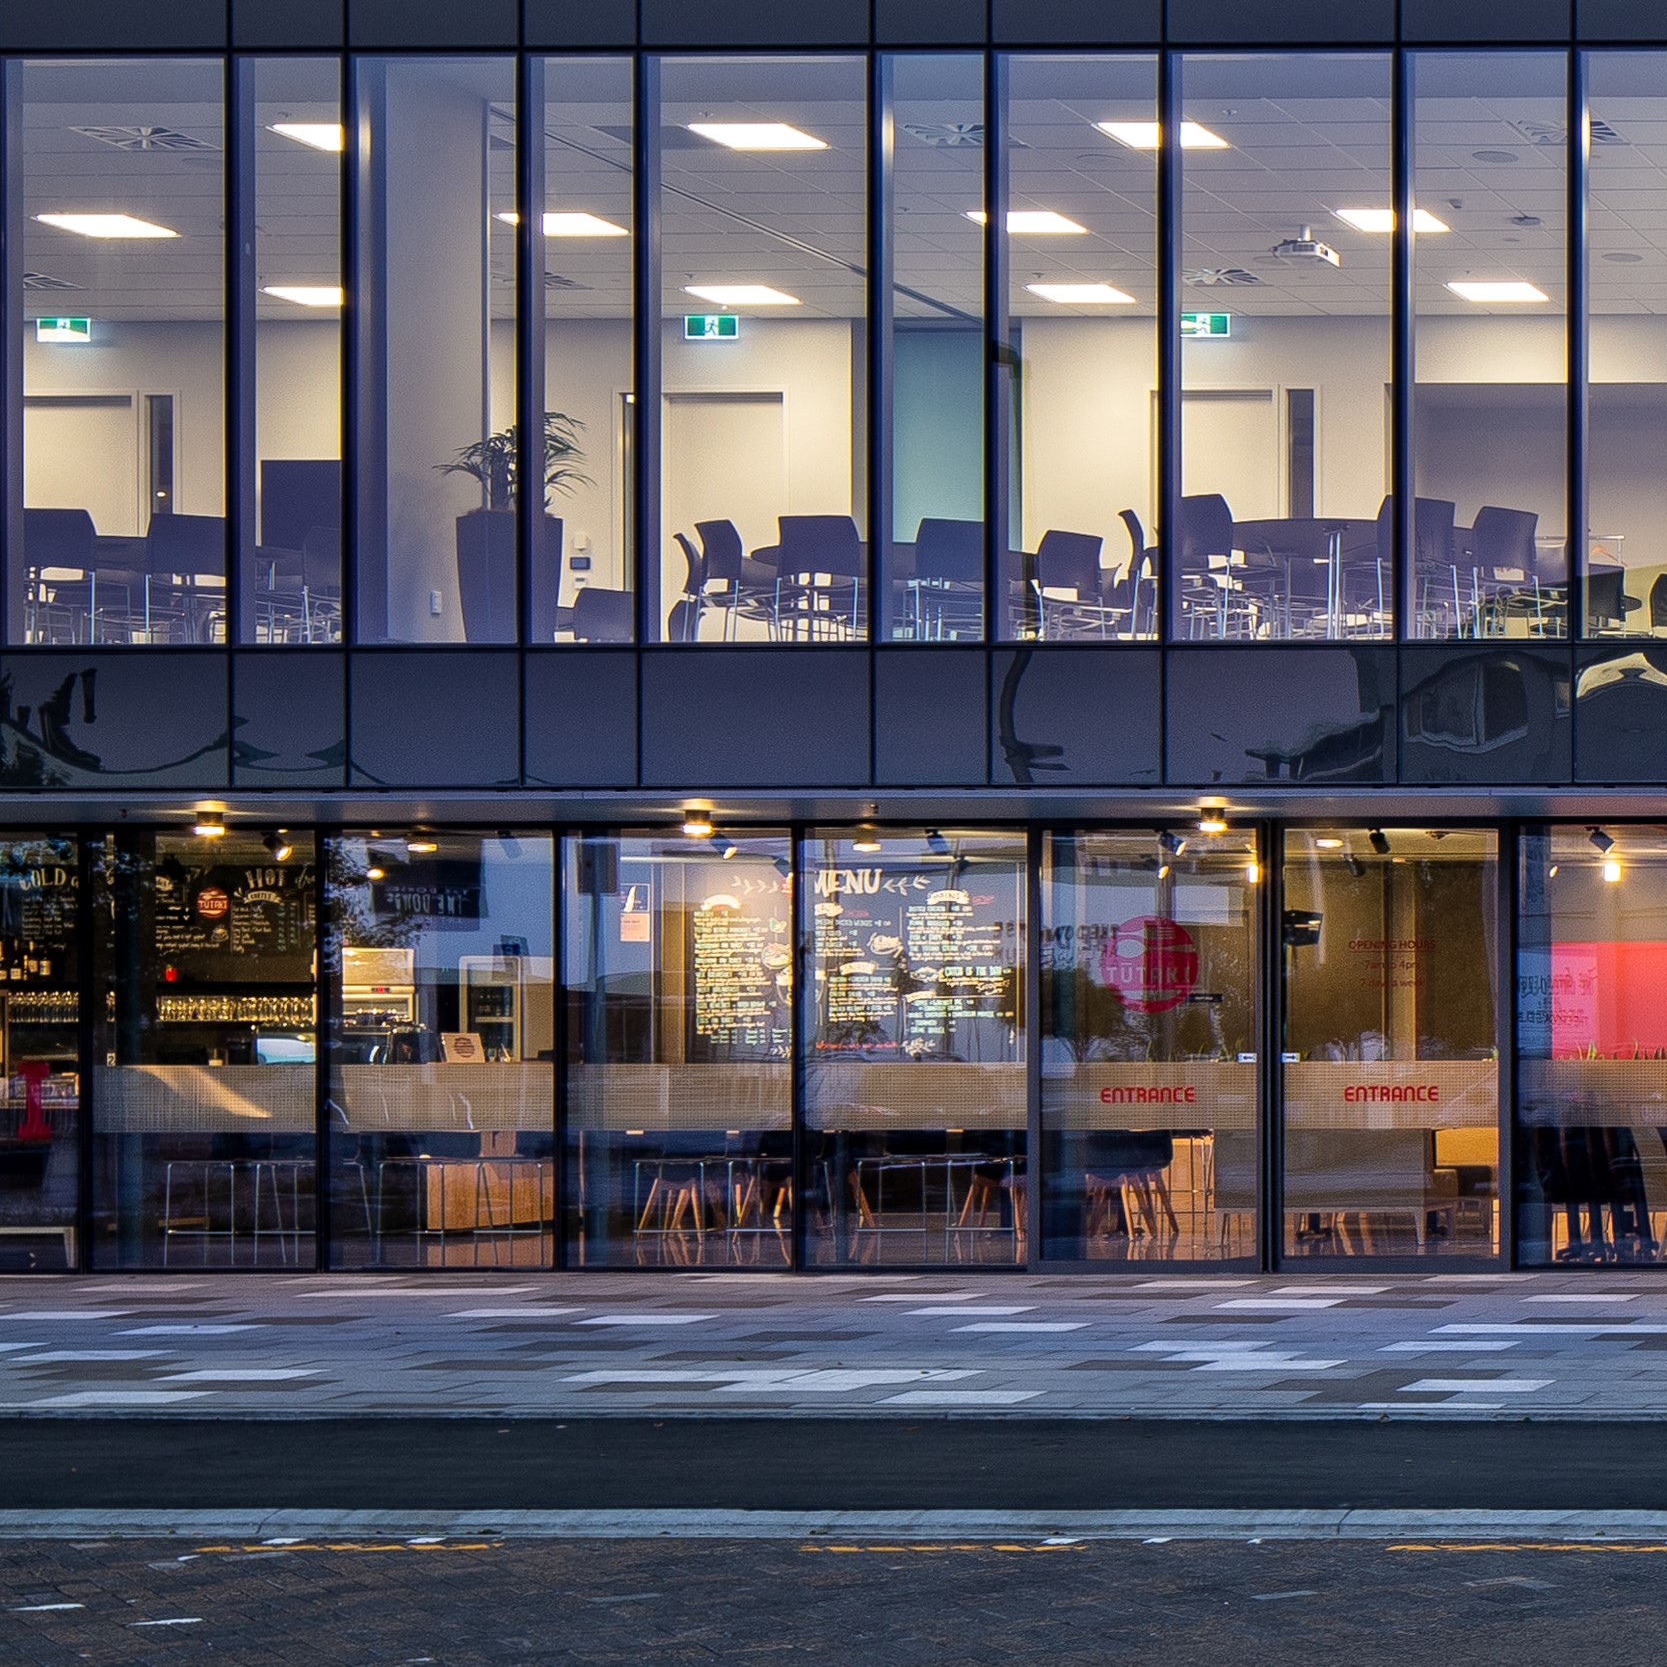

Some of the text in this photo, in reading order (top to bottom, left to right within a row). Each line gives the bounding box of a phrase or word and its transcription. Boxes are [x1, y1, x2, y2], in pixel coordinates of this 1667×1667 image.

[1348, 940, 1437, 950] OPENING HOURS
[1100, 1086, 1196, 1104] ENTRANCE
[1343, 1085, 1440, 1102] ENTRANCE
